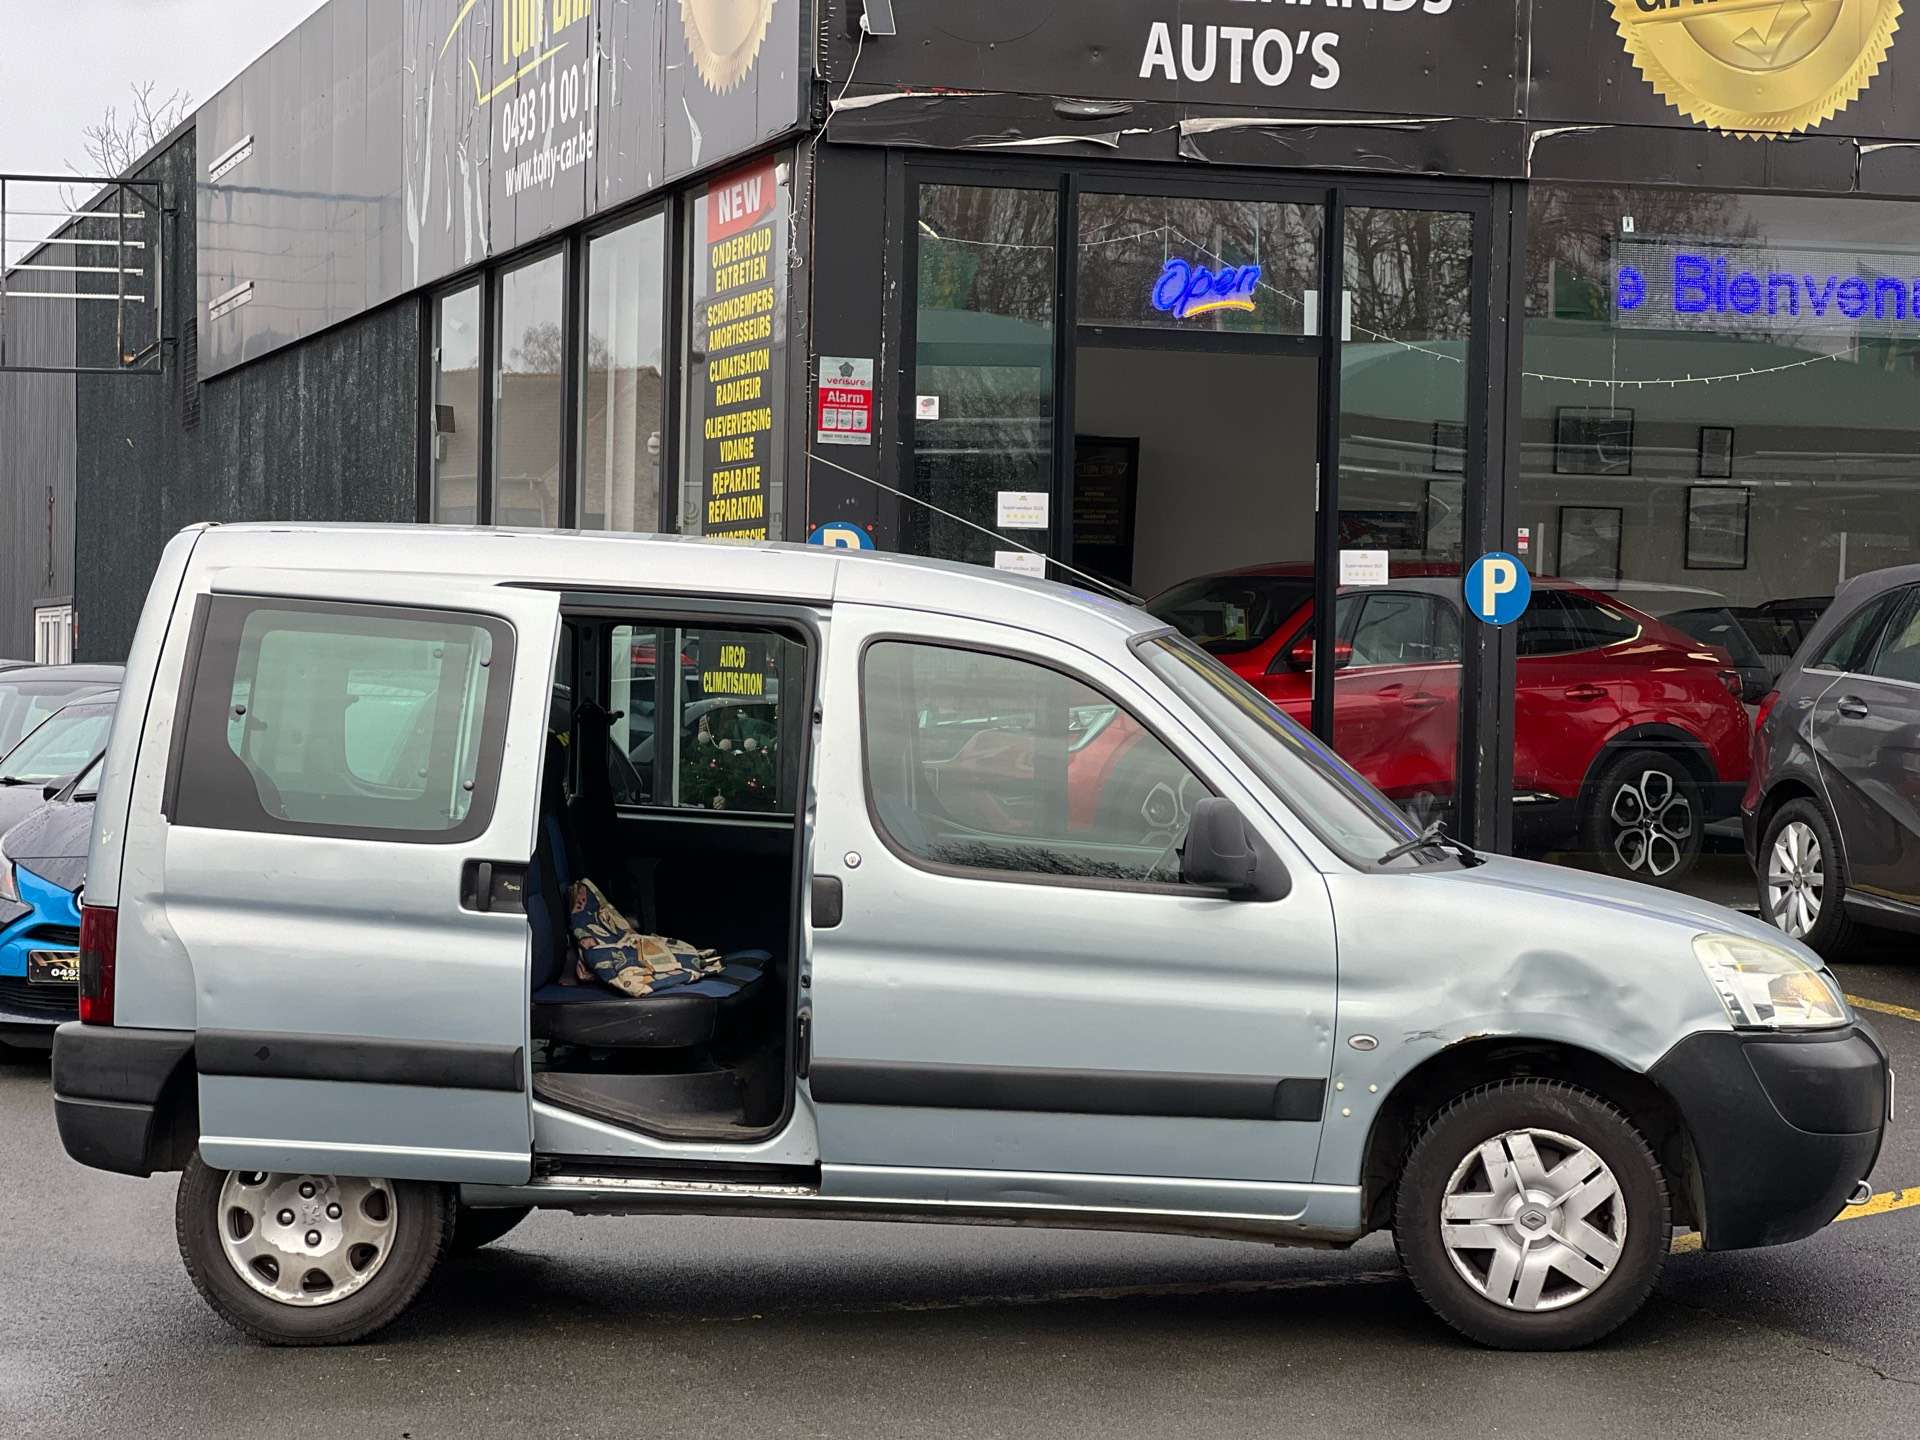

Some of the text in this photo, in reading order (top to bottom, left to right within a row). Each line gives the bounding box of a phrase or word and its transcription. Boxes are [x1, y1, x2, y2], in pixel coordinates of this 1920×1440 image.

[1139, 21, 1340, 89] AUTO'S
[503, 88, 536, 154] 0493
[540, 76, 555, 133] 11
[560, 64, 578, 123] 00
[505, 120, 594, 197] www.tony-car.be
[718, 176, 762, 224] NEW
[712, 227, 771, 269] ONDERHOUD
[716, 256, 767, 292] ENTRETIEN
[1152, 258, 1261, 318] Open
[1673, 254, 1920, 320] Bienven
[708, 287, 774, 327] SCHOKDEMPERS
[709, 314, 771, 352] AMORTISSEURS
[710, 348, 769, 382] CLIMATISATION
[826, 377, 866, 386] verisure
[716, 377, 761, 406] RADIATEUR
[827, 391, 864, 404] Alarm
[705, 407, 771, 440] OLIEVERVERSING
[720, 437, 754, 462] VIDANGE
[713, 466, 760, 495] REPARATIE
[708, 494, 763, 524] RÉPARATION
[1483, 559, 1517, 616] P
[720, 645, 746, 669] AIRCO
[703, 671, 763, 696] CLIMATISATION
